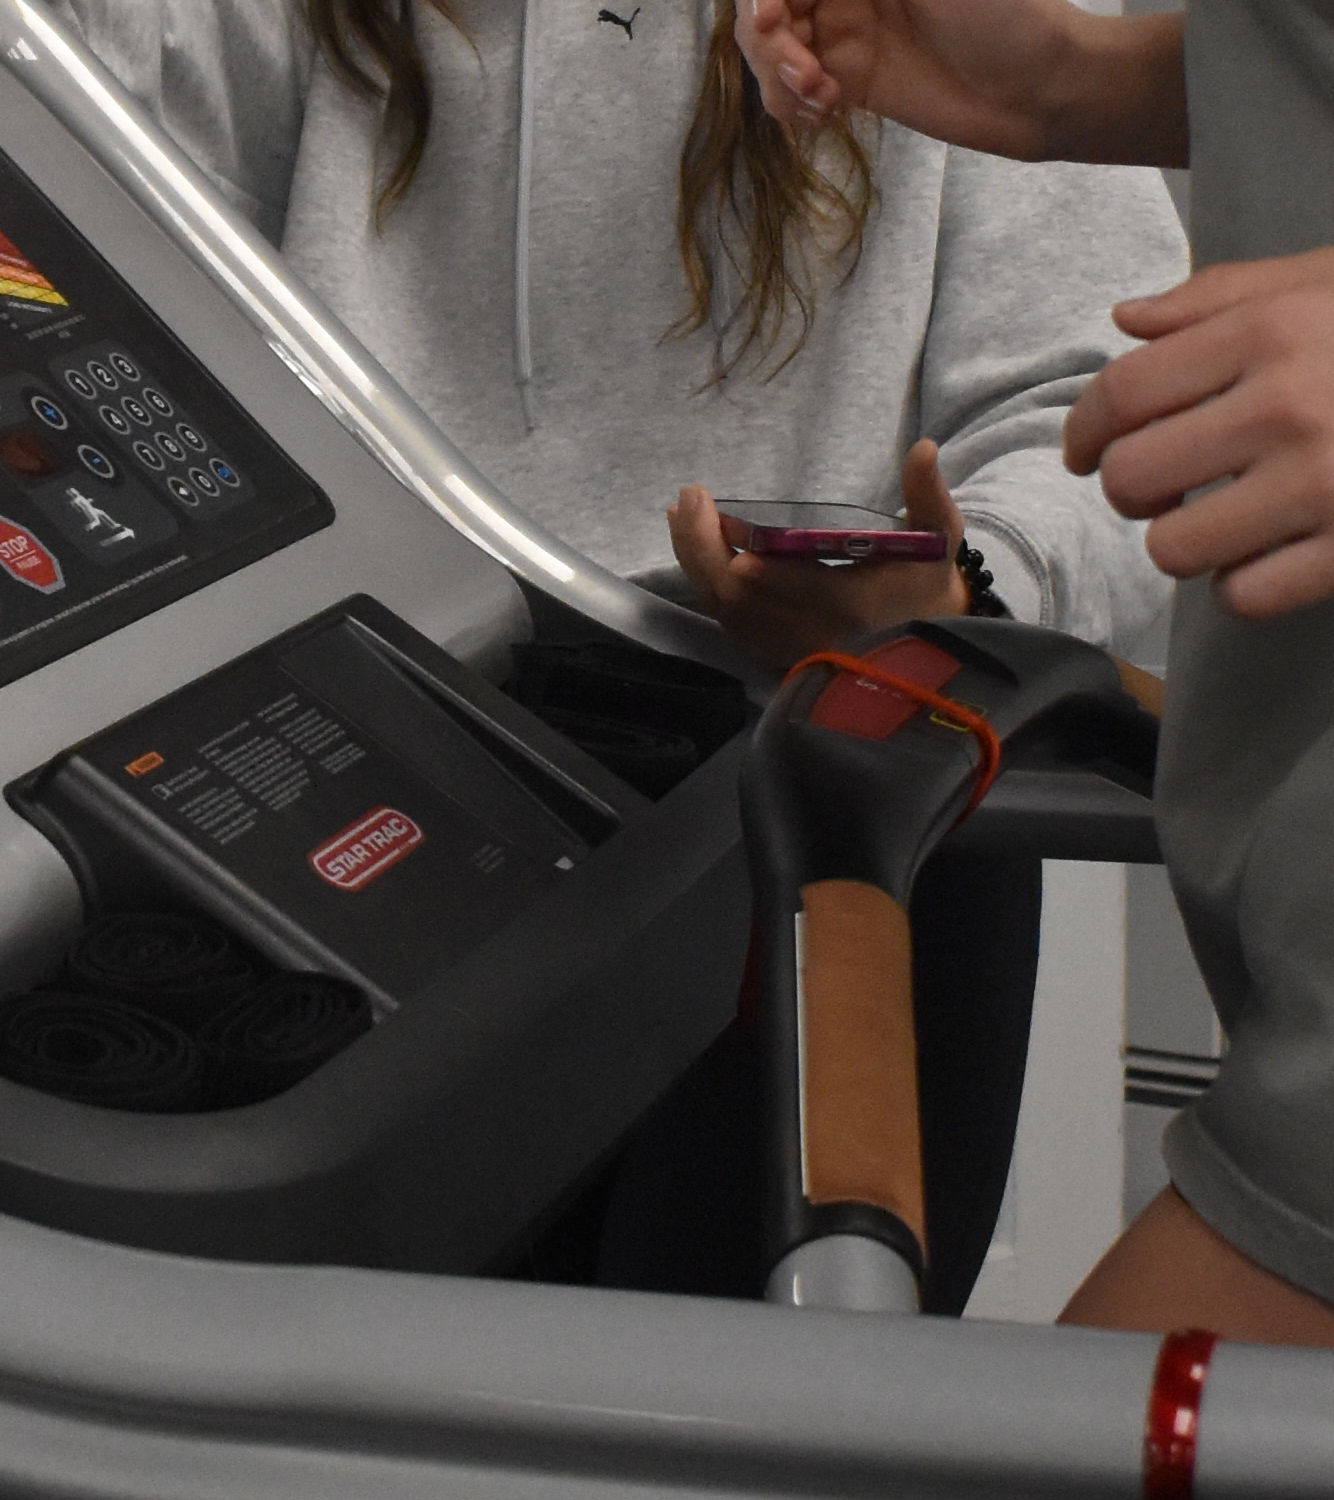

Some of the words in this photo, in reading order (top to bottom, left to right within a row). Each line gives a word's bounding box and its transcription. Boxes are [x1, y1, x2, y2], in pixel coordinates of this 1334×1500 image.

[118, 359, 133, 374] 3
[97, 368, 112, 383] 2
[75, 377, 89, 391] 1
[152, 395, 166, 409] 6
[130, 403, 144, 418] 5
[110, 412, 124, 426] 4
[185, 430, 199, 444] 9
[164, 439, 178, 453] 8
[142, 449, 156, 463] 7
[198, 475, 211, 488] 0
[326, 845, 372, 881] STAR
[362, 817, 408, 852] TRAC
